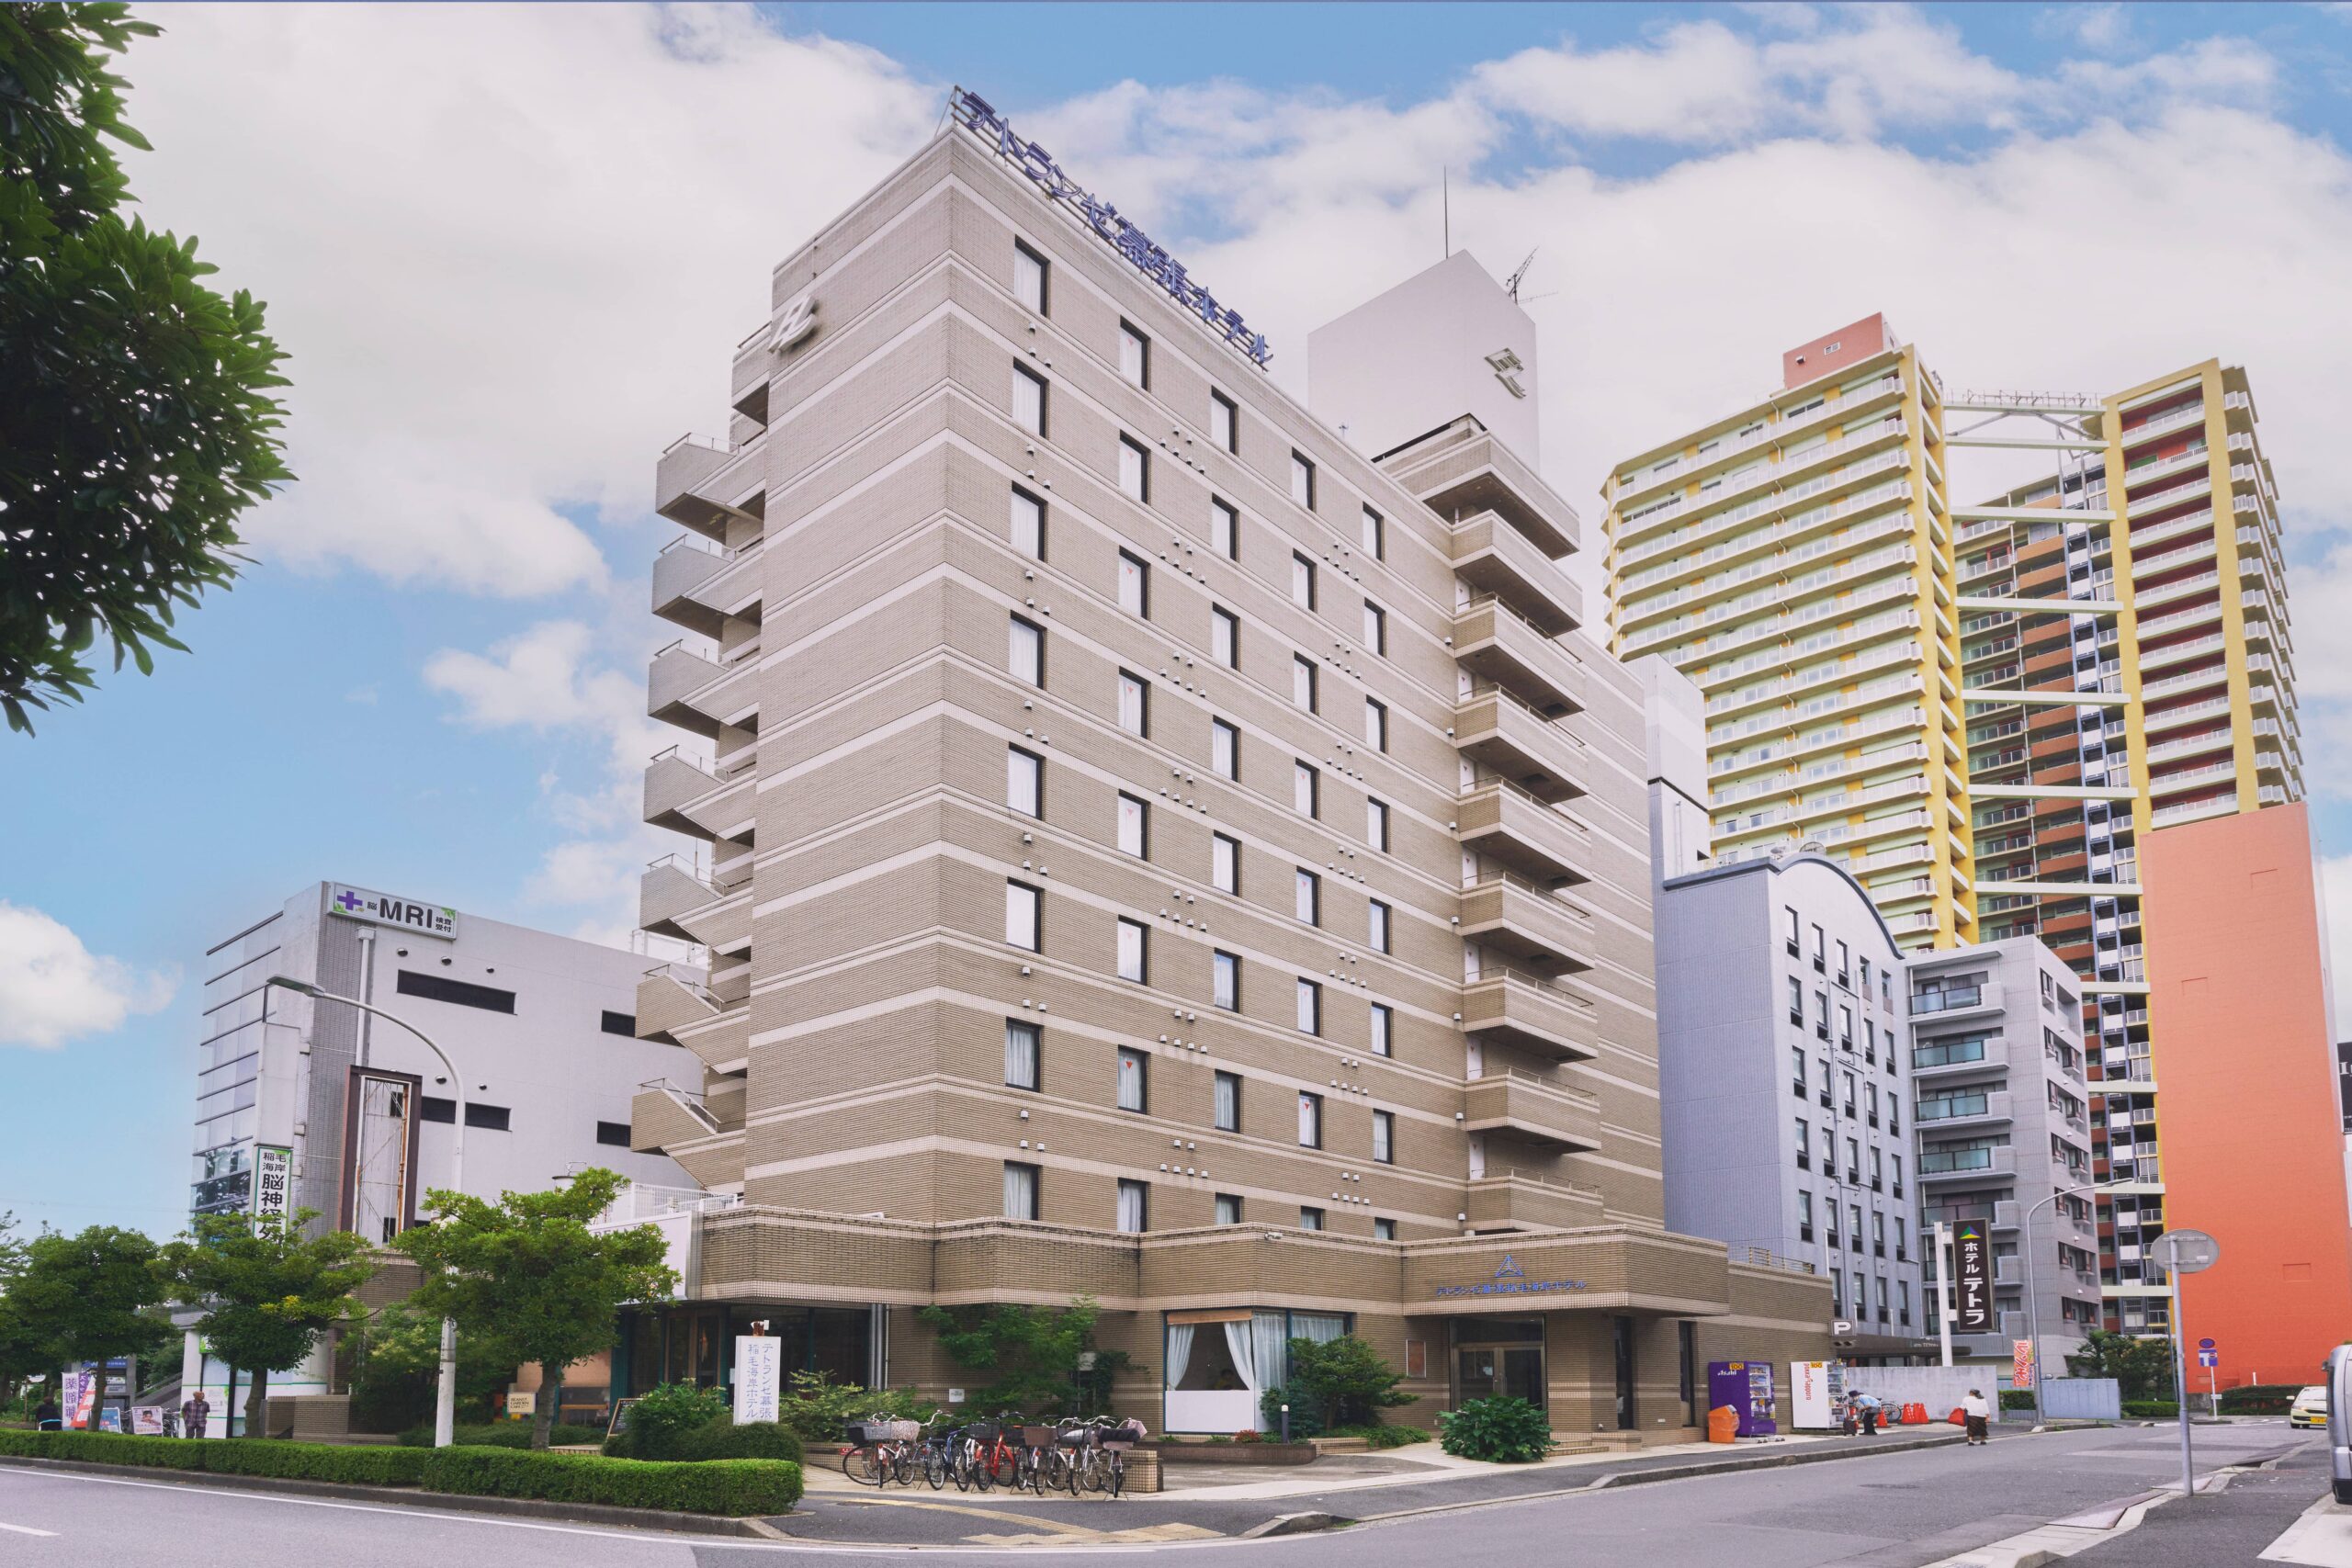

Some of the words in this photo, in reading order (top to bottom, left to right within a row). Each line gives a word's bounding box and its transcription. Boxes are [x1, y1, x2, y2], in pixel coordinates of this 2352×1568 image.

[379, 897, 433, 929] MRI
[435, 924, 451, 933] 受付
[263, 1152, 287, 1163] 稲毛
[262, 1162, 286, 1172] 海岸
[1834, 1322, 1851, 1335] P
[746, 1344, 759, 1418] 稲毛海岸ホテル
[760, 1343, 774, 1418] テトランゼ幕張
